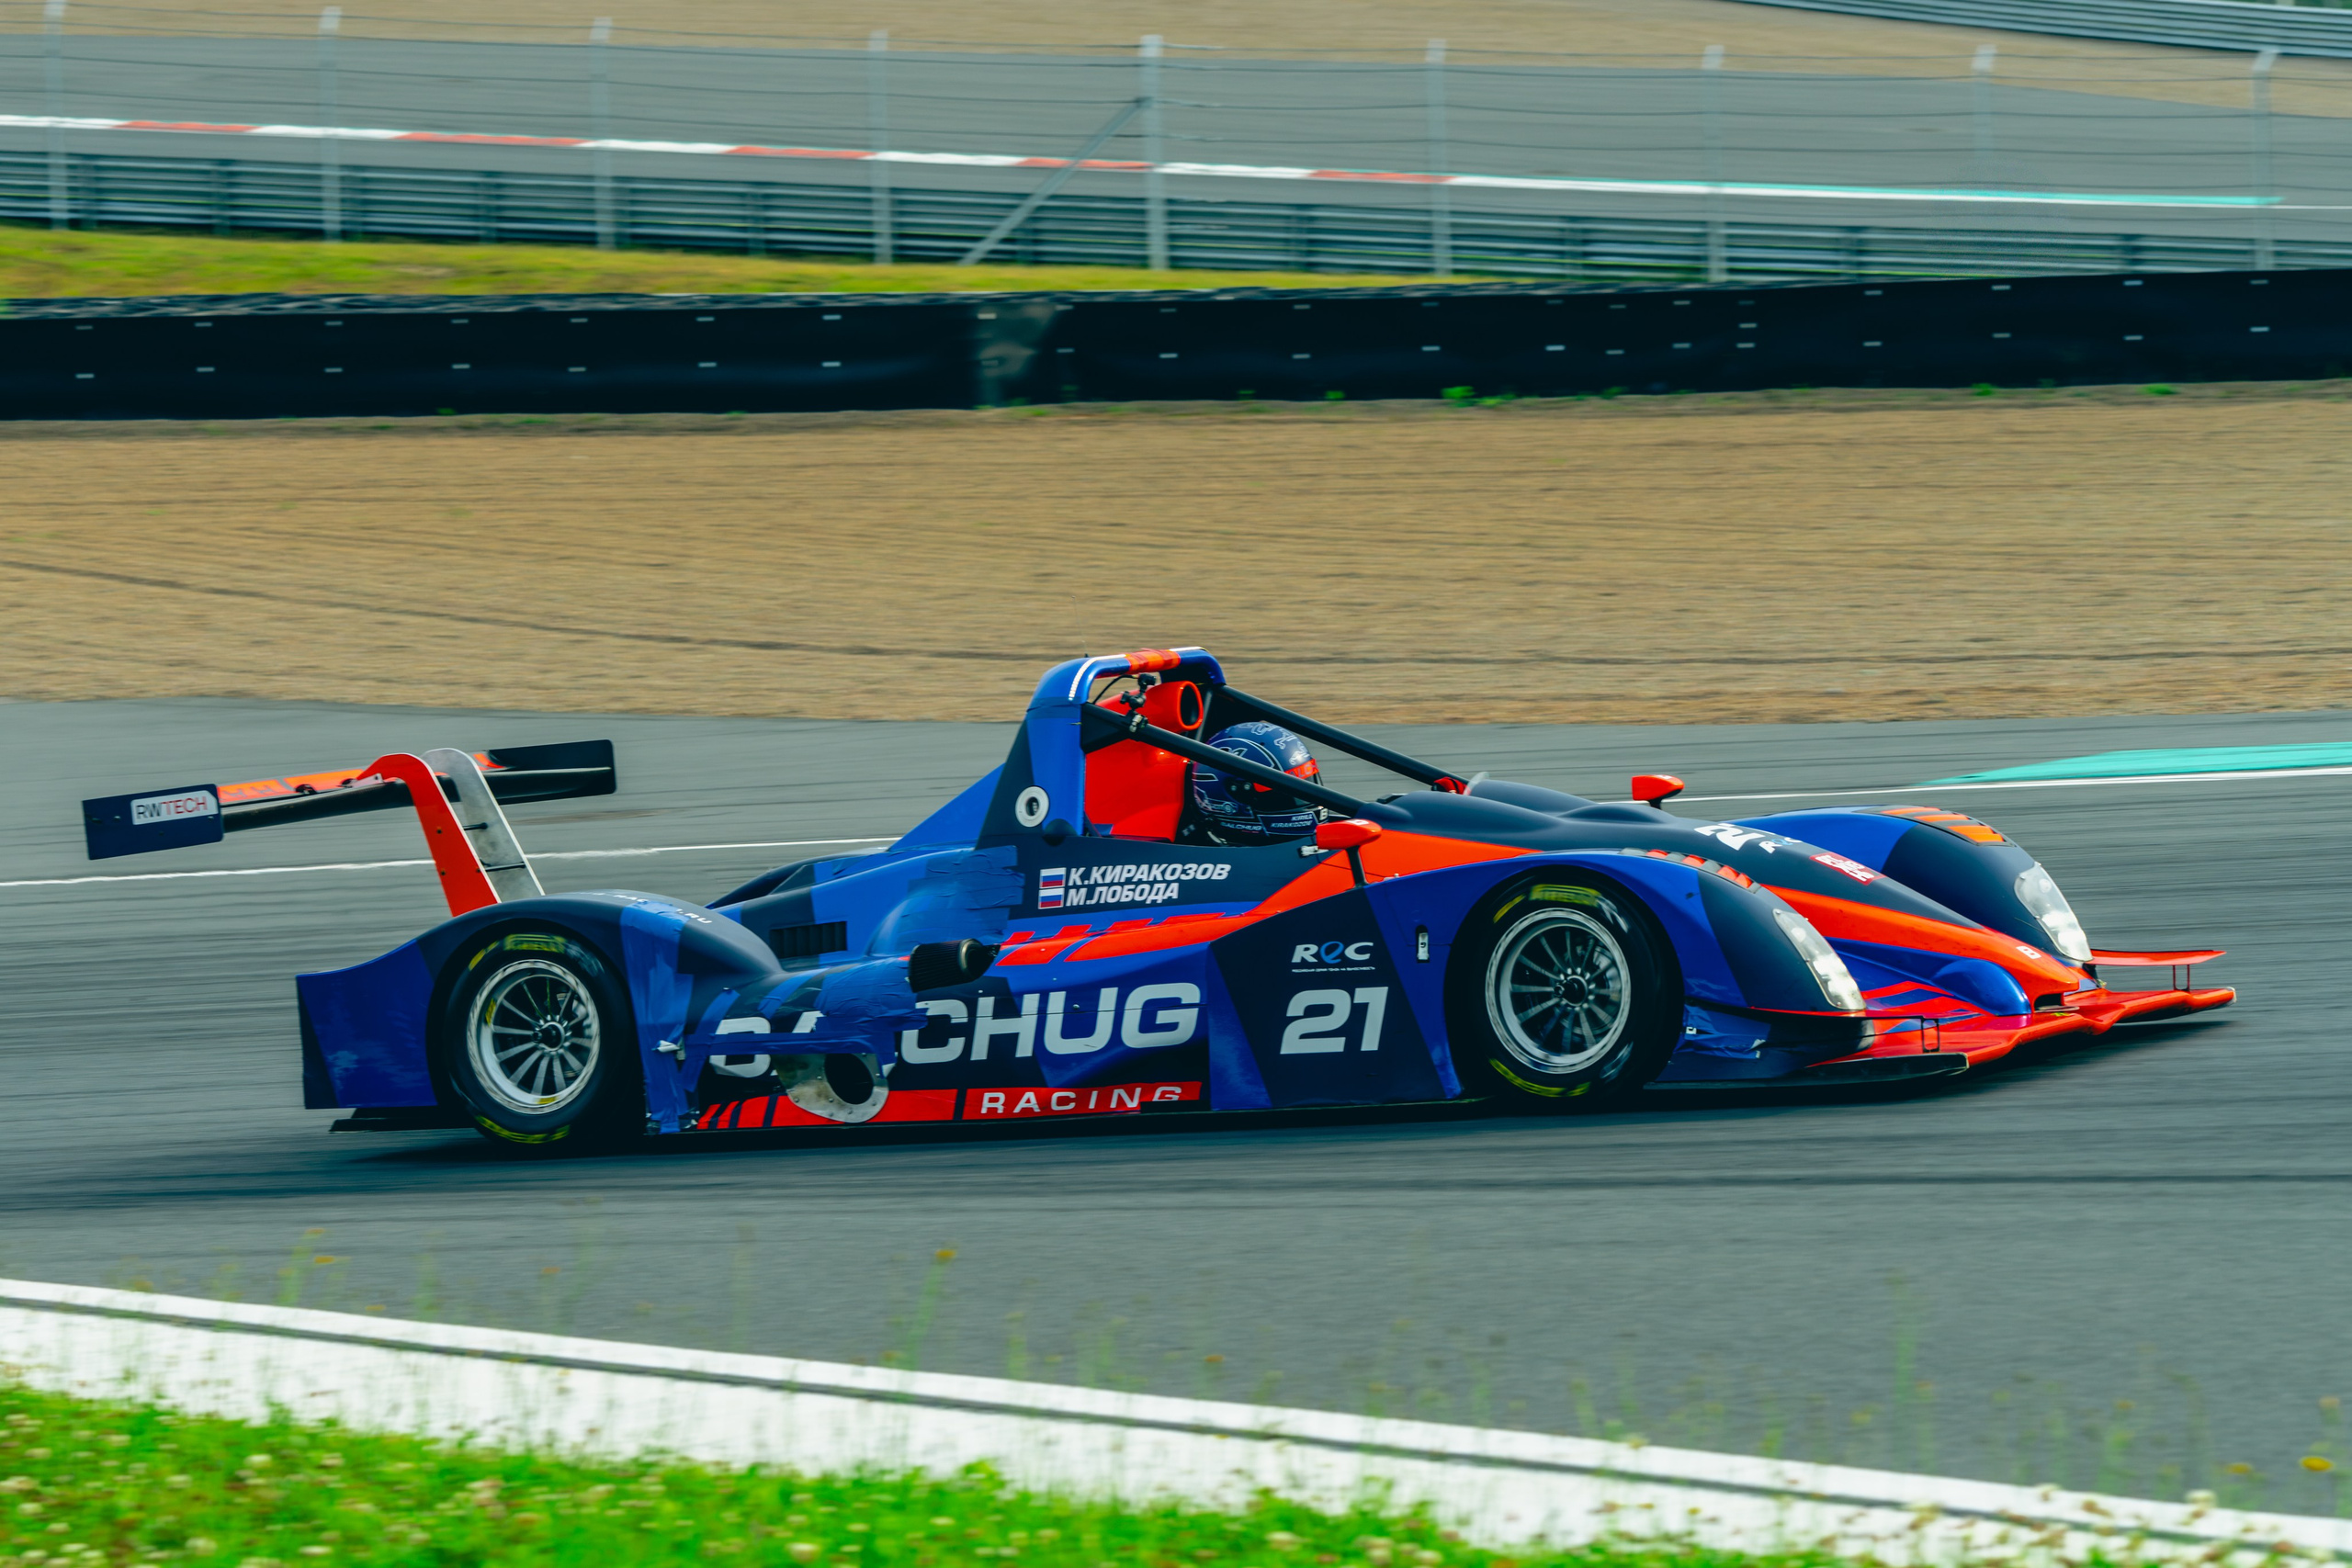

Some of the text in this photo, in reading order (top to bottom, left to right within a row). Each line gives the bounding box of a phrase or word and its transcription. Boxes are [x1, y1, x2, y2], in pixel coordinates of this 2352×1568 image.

[136, 796, 208, 820] RWTECH
[1068, 863, 1232, 886] К.КИРАКОЗОВ
[1066, 883, 1180, 907] М.ЛОБОДА
[1280, 986, 1389, 1055] 21
[980, 1085, 1183, 1114] RACING
